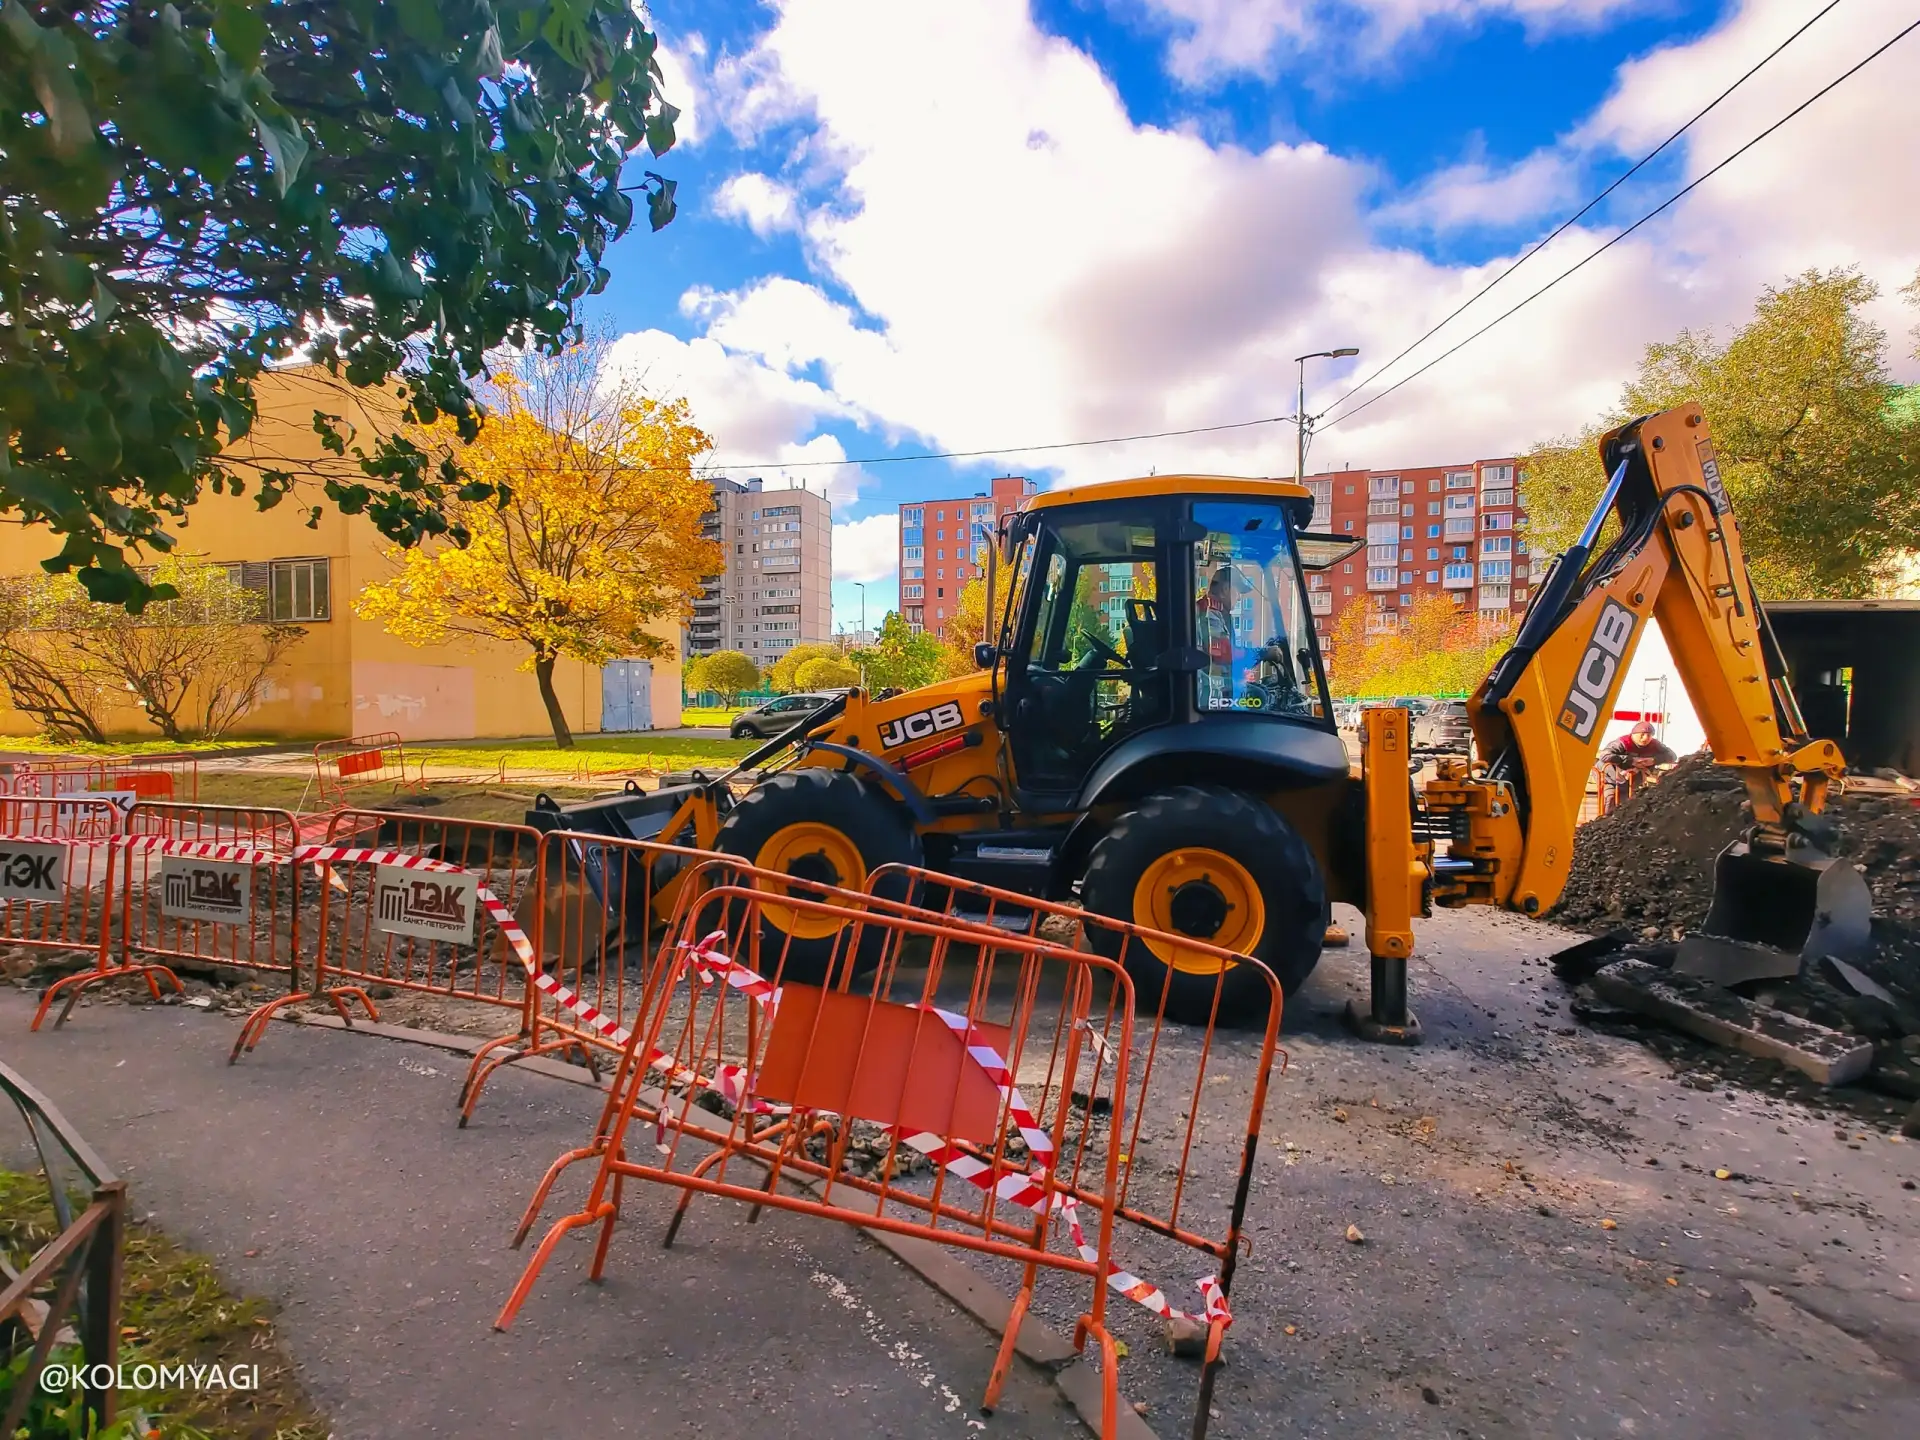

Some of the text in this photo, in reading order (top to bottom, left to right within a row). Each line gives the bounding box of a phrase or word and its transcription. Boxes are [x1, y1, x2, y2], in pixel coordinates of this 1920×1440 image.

[1569, 604, 1633, 737] JCB
[883, 703, 962, 746] JCB
[411, 881, 466, 915] ТЭК
[403, 916, 466, 931] САНКТ-ПЕТЕРБУРГ
